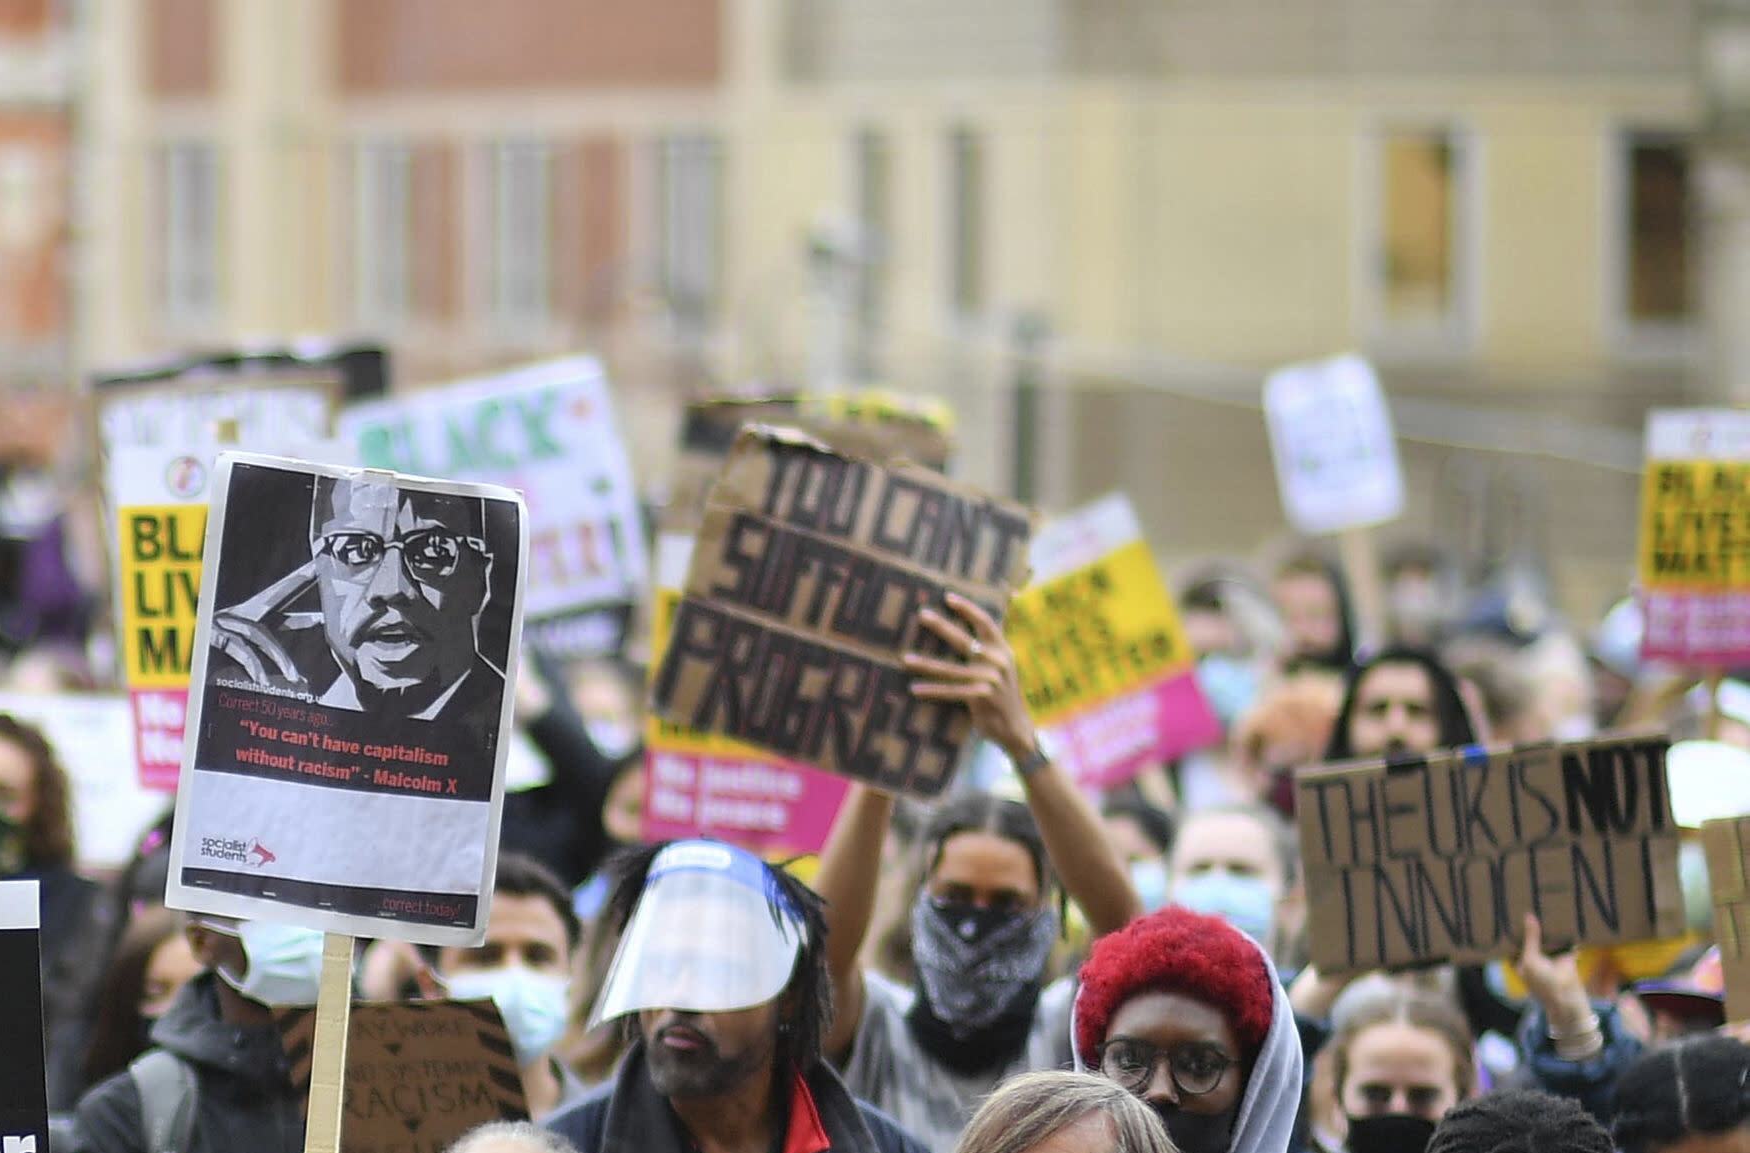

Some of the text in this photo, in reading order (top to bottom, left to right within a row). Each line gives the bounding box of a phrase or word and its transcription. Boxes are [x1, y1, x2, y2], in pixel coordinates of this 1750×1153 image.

[218, 691, 260, 714] Correct
[277, 704, 306, 721] years
[653, 598, 971, 798] PROGRESS
[235, 746, 295, 772] without
[373, 768, 442, 793] Malcolm
[446, 778, 458, 795] X
[322, 735, 361, 756] have
[363, 742, 450, 768] capitalism
[1300, 770, 1420, 864] THE
[1506, 755, 1561, 848] IS
[1561, 742, 1672, 836] NOT
[200, 846, 249, 864] students
[201, 835, 248, 852] socialist
[1341, 835, 1670, 968] INNOCENT
